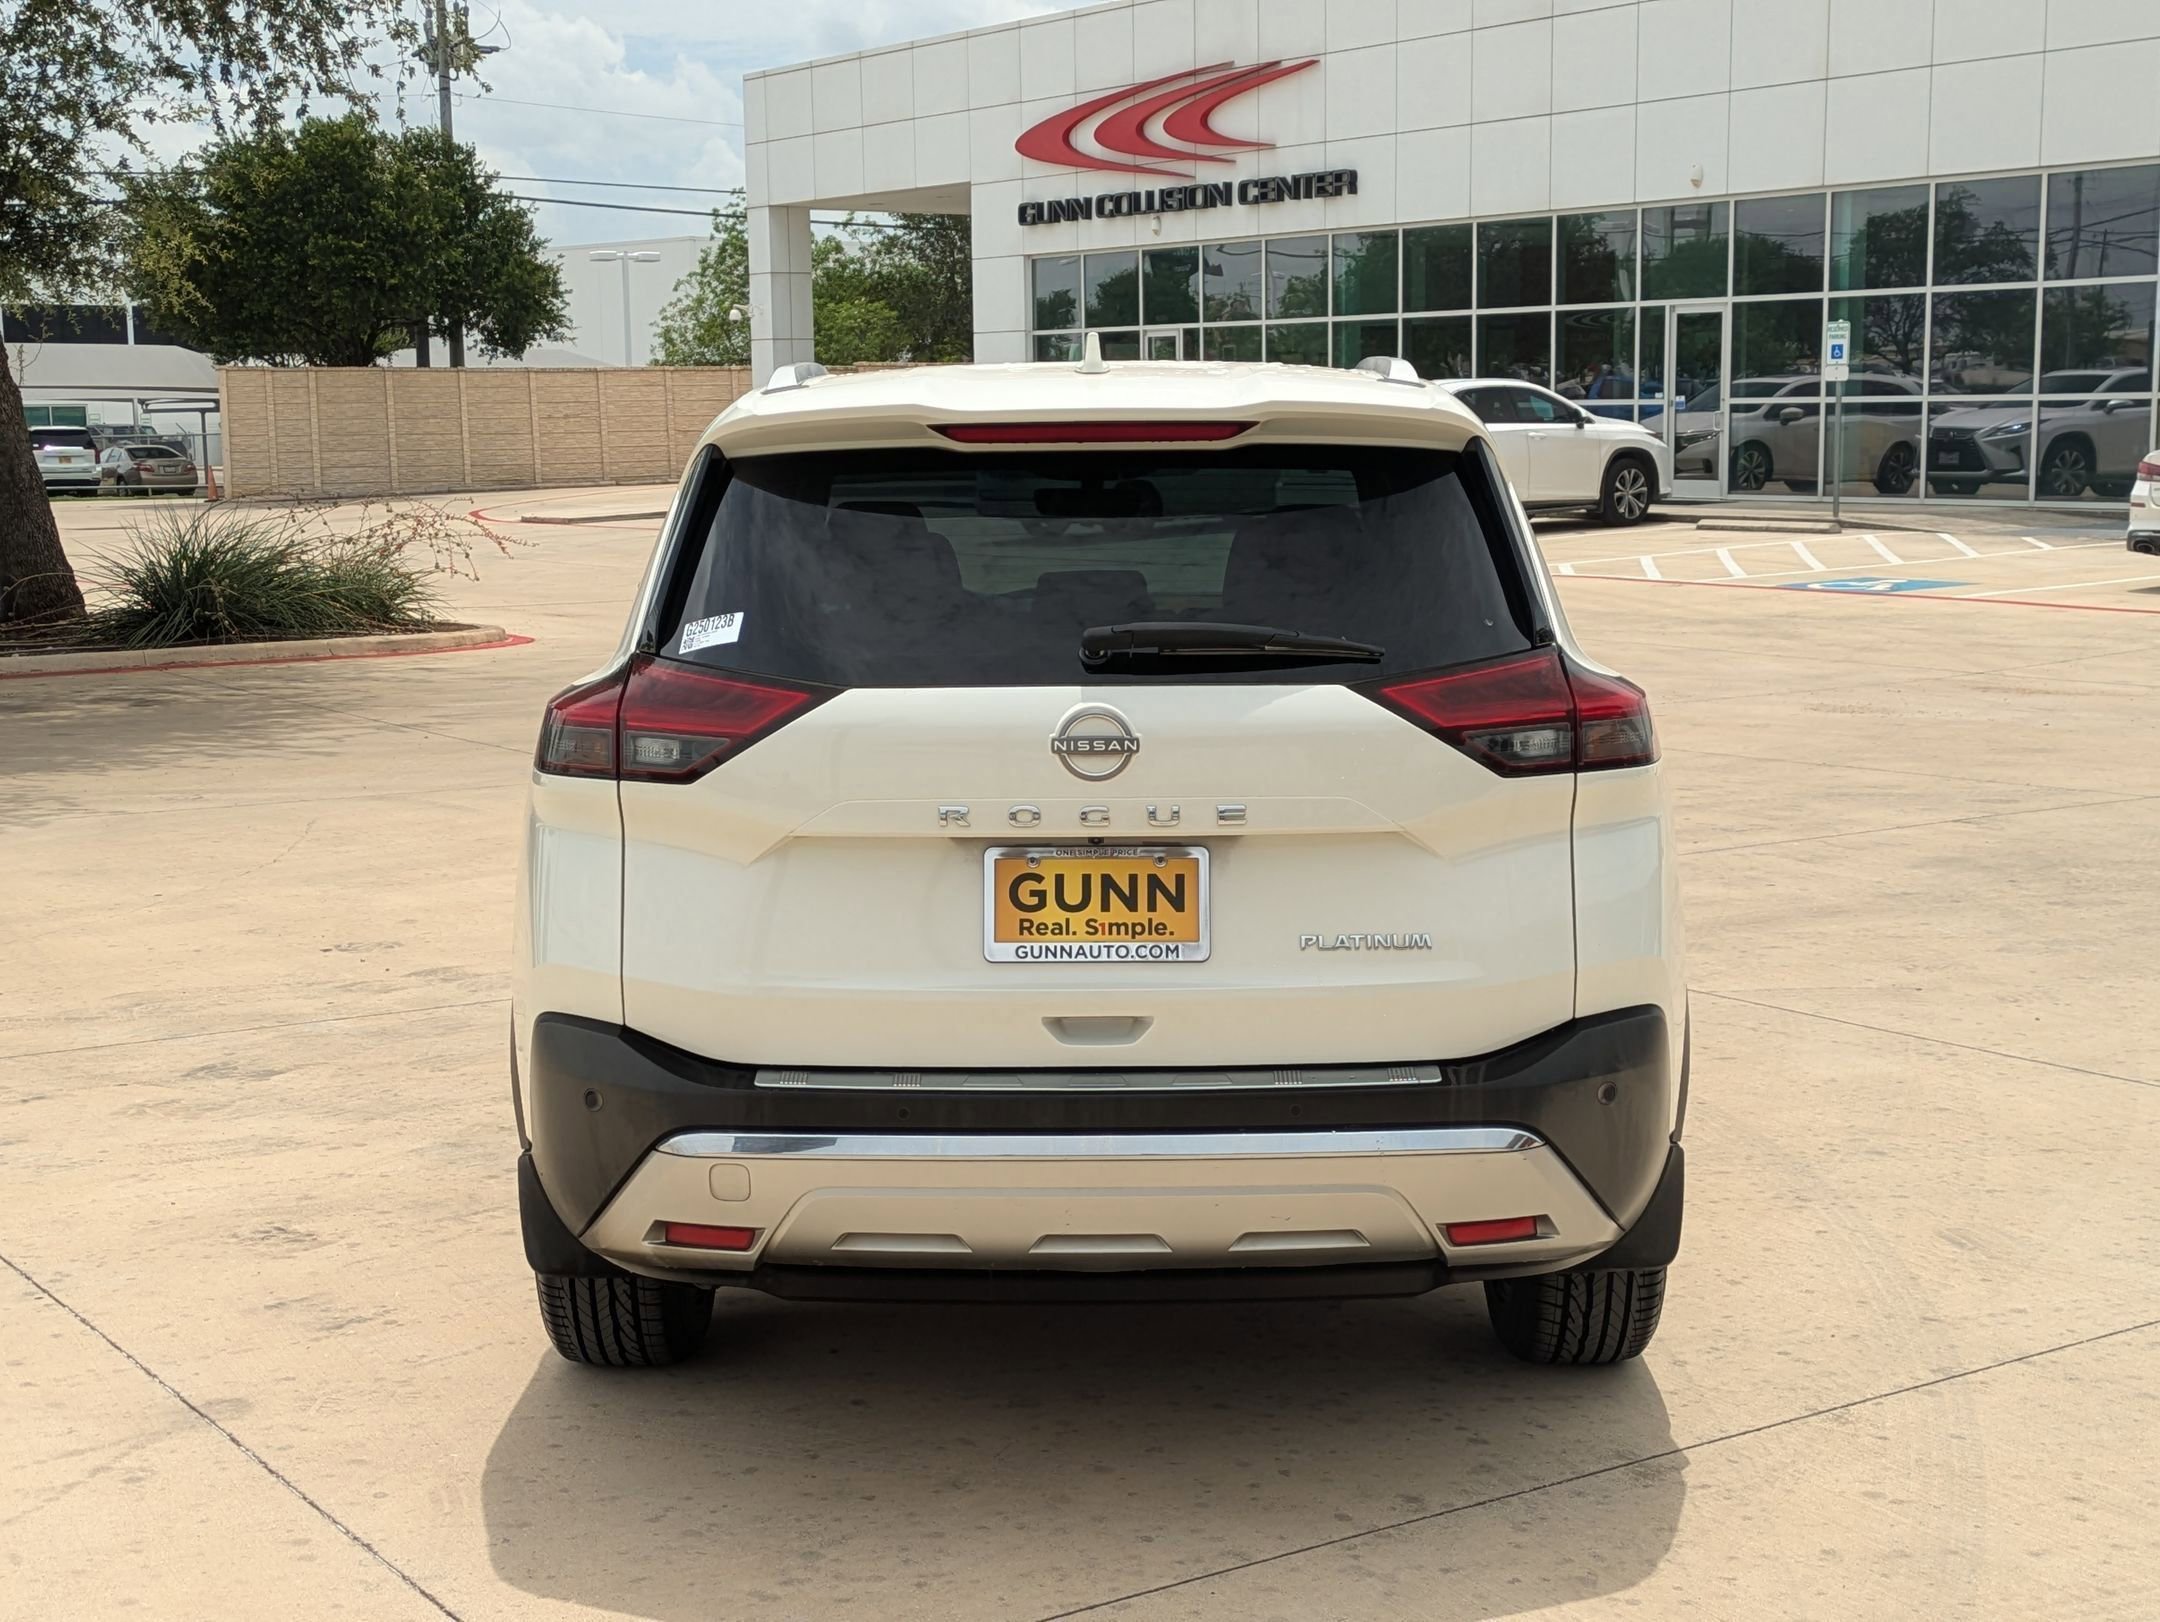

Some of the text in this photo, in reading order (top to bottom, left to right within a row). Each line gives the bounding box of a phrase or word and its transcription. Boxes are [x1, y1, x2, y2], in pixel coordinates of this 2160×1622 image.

[1018, 168, 1358, 226] GUNN COLLISION CENTER
[686, 613, 735, 637] G250123B
[1054, 739, 1138, 752] NISSAN
[937, 804, 1248, 827] ROGUE
[1055, 849, 1075, 857] ONE
[1112, 849, 1137, 857] PRICE
[1008, 872, 1186, 914] GUNN
[1018, 917, 1077, 937] Real.
[1015, 944, 1180, 960] GUNNAUTO.COM
[1300, 934, 1432, 950] PLATINUM
